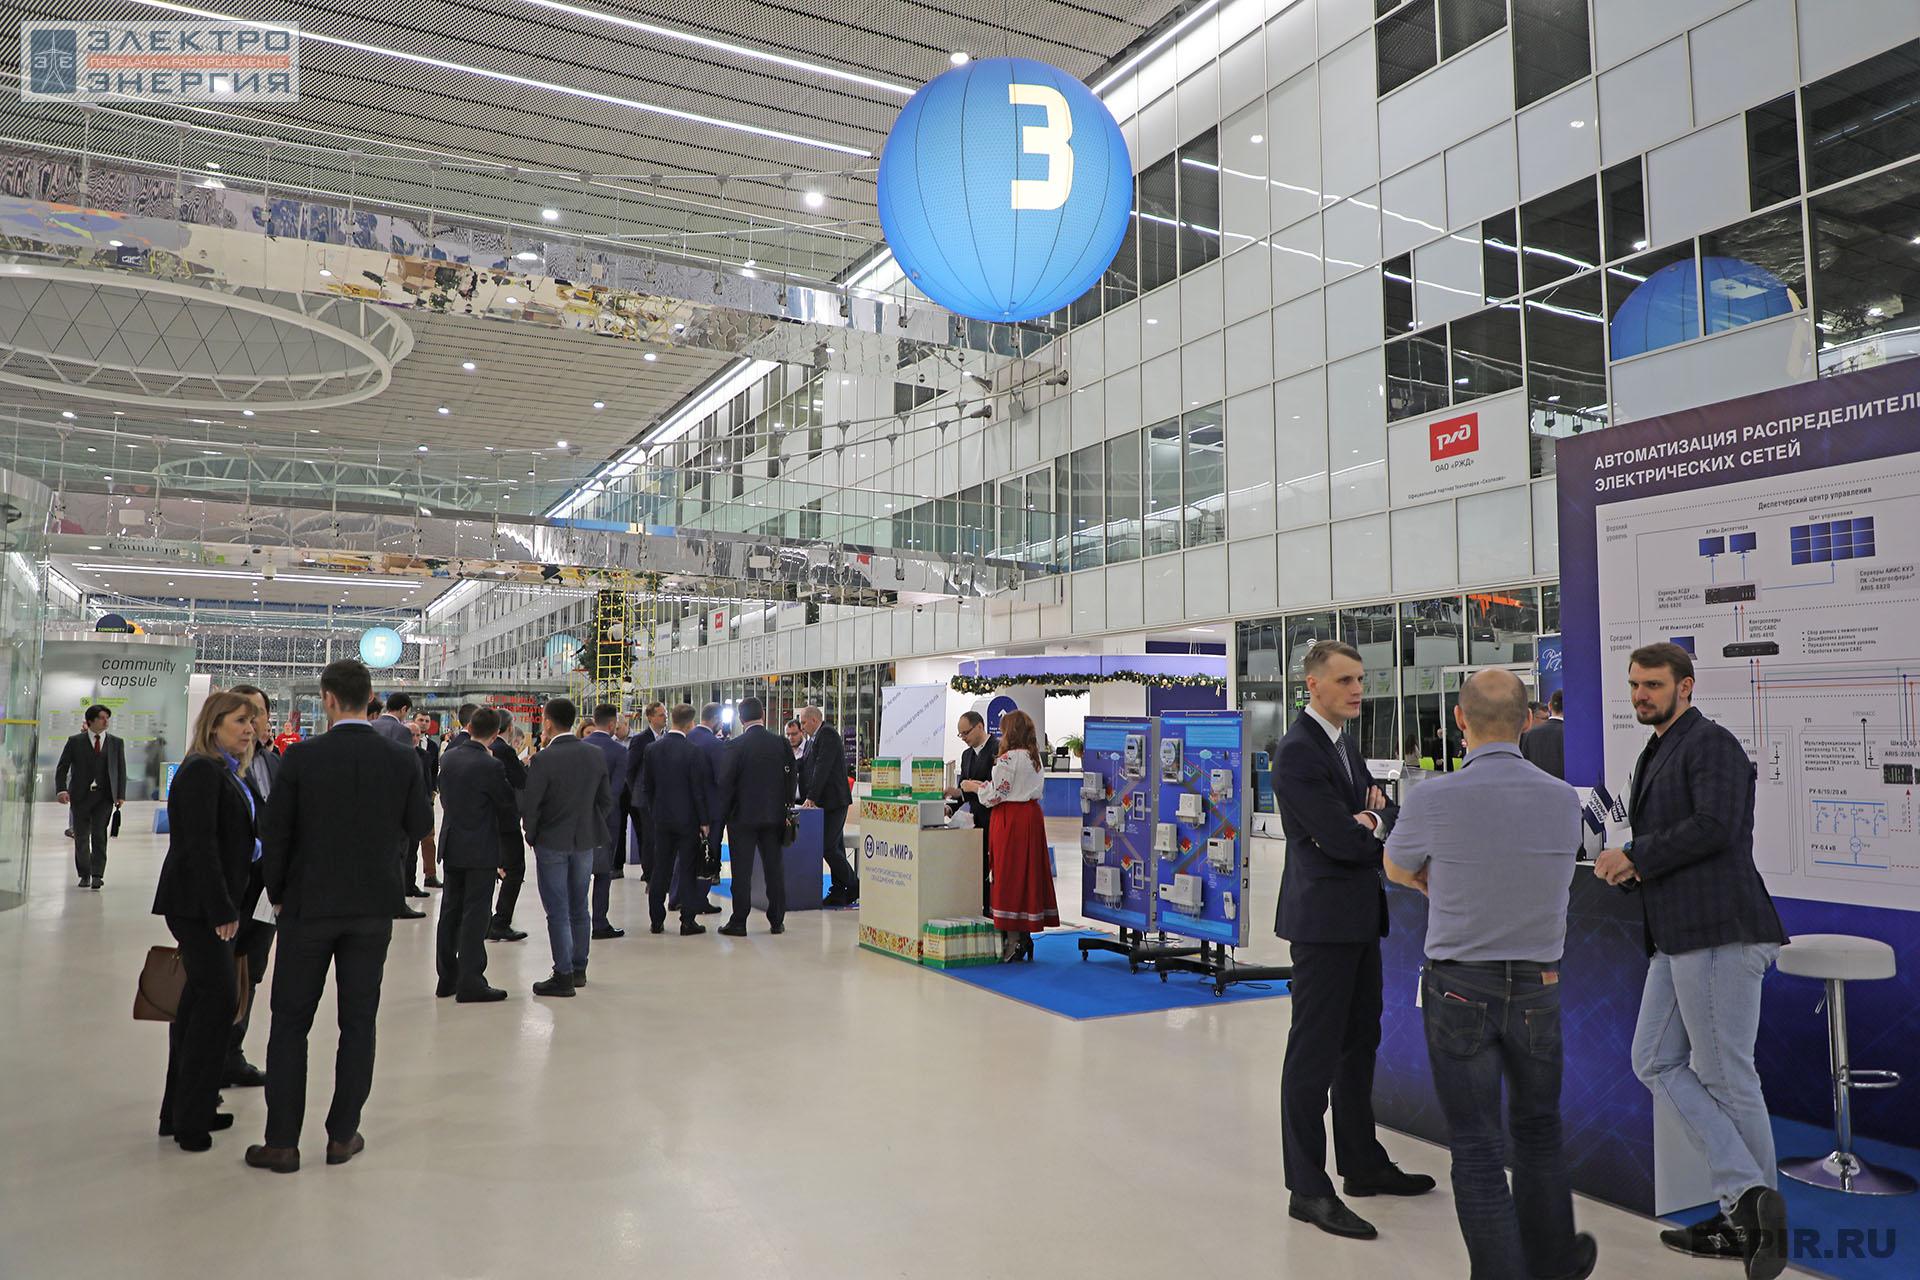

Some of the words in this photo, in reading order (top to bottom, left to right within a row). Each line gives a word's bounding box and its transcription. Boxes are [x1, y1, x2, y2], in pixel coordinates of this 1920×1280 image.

[1008, 83, 1075, 211] 3
[1594, 429, 1737, 471] АВТОМАТИЗАЦИЯ
[1435, 463, 1450, 473] ОАО
[1451, 458, 1475, 469] «РЖД»
[1594, 454, 1735, 492] ЭЛЕКТРИЧЕСКИХ
[1740, 438, 1801, 466] СЕТЕЙ
[1758, 495, 1808, 511] Диспетчерский
[1808, 493, 1829, 503] центр
[1830, 487, 1872, 500] управления
[374, 636, 387, 657] 5
[1609, 634, 1632, 643] Средний
[1610, 643, 1632, 653] уровень
[101, 658, 177, 675] community
[101, 674, 158, 689] capsule
[1612, 713, 1633, 721] Нижний
[1612, 722, 1635, 731] уровень
[876, 841, 889, 857] НПО
[890, 843, 914, 861] «МИР»
